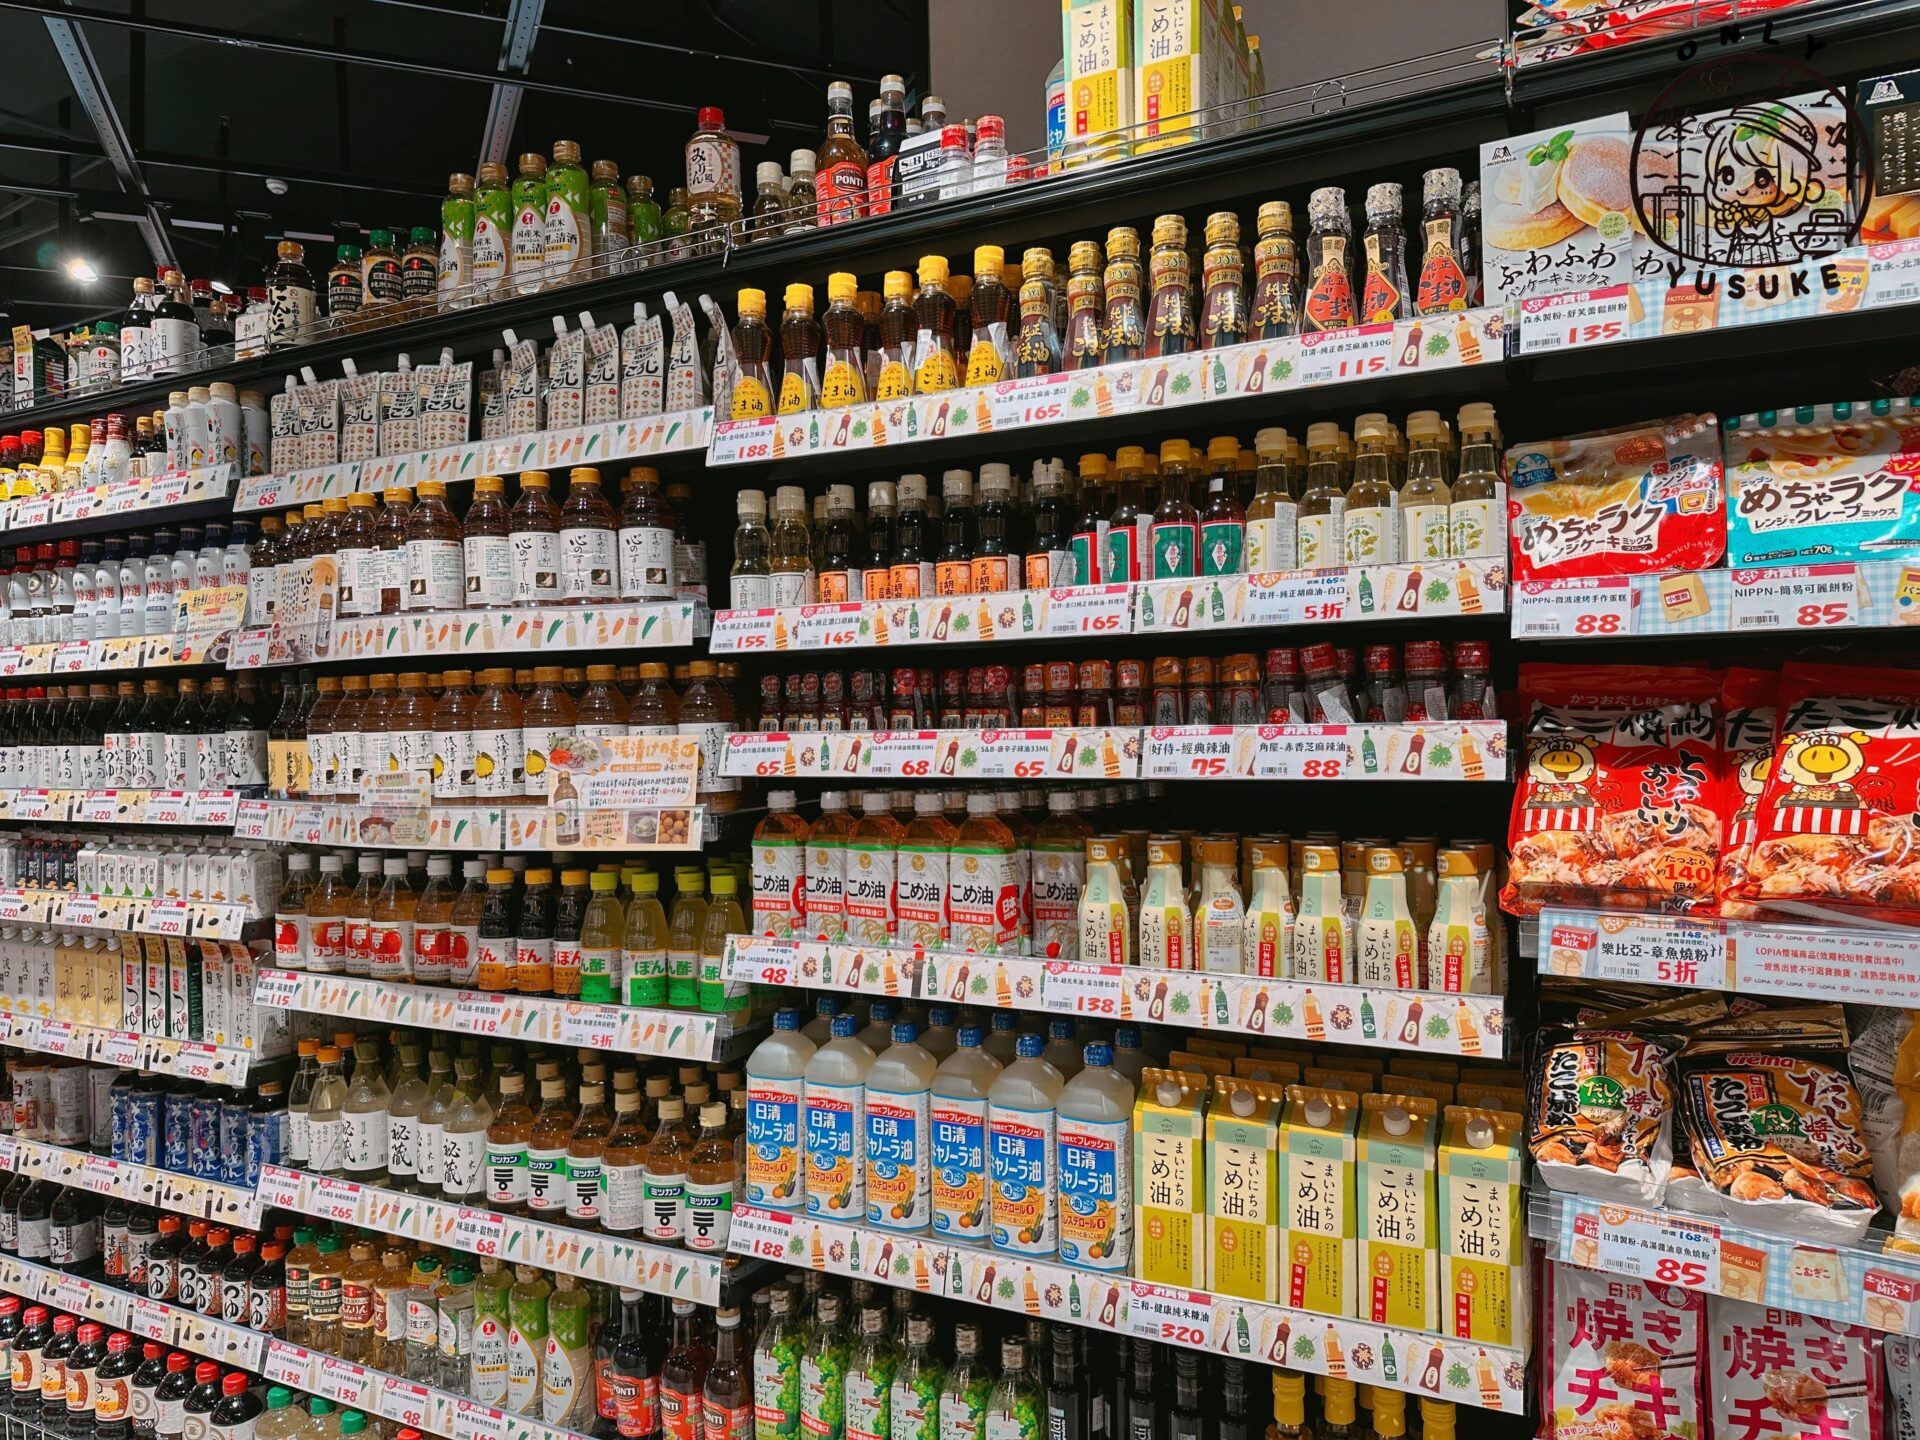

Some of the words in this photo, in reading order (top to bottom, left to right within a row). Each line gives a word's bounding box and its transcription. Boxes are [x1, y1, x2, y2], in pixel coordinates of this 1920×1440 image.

[1078, 10, 1097, 74] こめ油
[900, 153, 922, 170] S&B
[835, 174, 863, 188] PONTI
[1499, 243, 1616, 290] ふわふわ
[1570, 322, 1620, 343] 135
[1340, 358, 1382, 376] 115
[1026, 406, 1058, 420] 165
[740, 445, 767, 457] 188
[258, 493, 275, 506] 68
[1740, 473, 1906, 513] めちゃラク
[1797, 505, 1862, 524] クレープ
[1861, 507, 1898, 519] ミックス
[1305, 604, 1341, 619] 5折
[1798, 604, 1846, 625] 85
[1083, 616, 1118, 630] 165
[1576, 615, 1620, 633] 88
[737, 635, 766, 648] 155
[825, 632, 853, 644] 145
[757, 761, 779, 775] 65
[902, 761, 929, 775] 68
[1015, 762, 1043, 778] 65
[1192, 758, 1225, 775] 75
[1303, 760, 1340, 778] 88
[753, 874, 790, 893] こめ油
[1665, 864, 1711, 884] 140
[806, 875, 842, 894] こめ油
[848, 879, 886, 900] こめ油
[899, 881, 940, 902] こめ油
[952, 883, 994, 905] こめ油
[1561, 938, 1580, 948] MIX
[762, 968, 787, 984] 98
[1658, 961, 1697, 984] 5折
[1078, 997, 1113, 1013] 138
[473, 1018, 496, 1032] 118
[755, 1103, 780, 1121] 日清
[811, 1110, 836, 1129] 日清
[872, 1118, 898, 1137] 日清
[939, 1124, 966, 1144] 日清
[998, 1136, 1025, 1157] 日清
[490, 1155, 518, 1164] ミツカン
[1067, 1148, 1096, 1169] 日清
[1150, 1138, 1171, 1205] こめ油
[1175, 1140, 1185, 1207] まいにちの
[650, 1187, 681, 1196] ミツカン
[1223, 1148, 1244, 1216] こめ油
[1248, 1150, 1258, 1219] まいにちの
[689, 1196, 719, 1206] ミツカン
[1297, 1160, 1319, 1230] こめ油
[1323, 1163, 1334, 1232] まいにちの
[1377, 1169, 1400, 1240] こめ油
[1405, 1173, 1416, 1242] まいにちの
[1460, 1183, 1485, 1256] こめ油
[1488, 1186, 1501, 1258] まいにちの
[477, 1240, 495, 1254] 68
[755, 1240, 783, 1257] 188
[1655, 1259, 1707, 1286] 85
[1608, 1283, 1642, 1301] 日清
[1876, 1285, 1900, 1297] MIX
[1567, 1297, 1682, 1355] 焼き
[1767, 1308, 1803, 1327] 日清
[1163, 1324, 1204, 1344] 320
[1724, 1325, 1848, 1384] 焼き
[613, 1385, 637, 1396] PONTI
